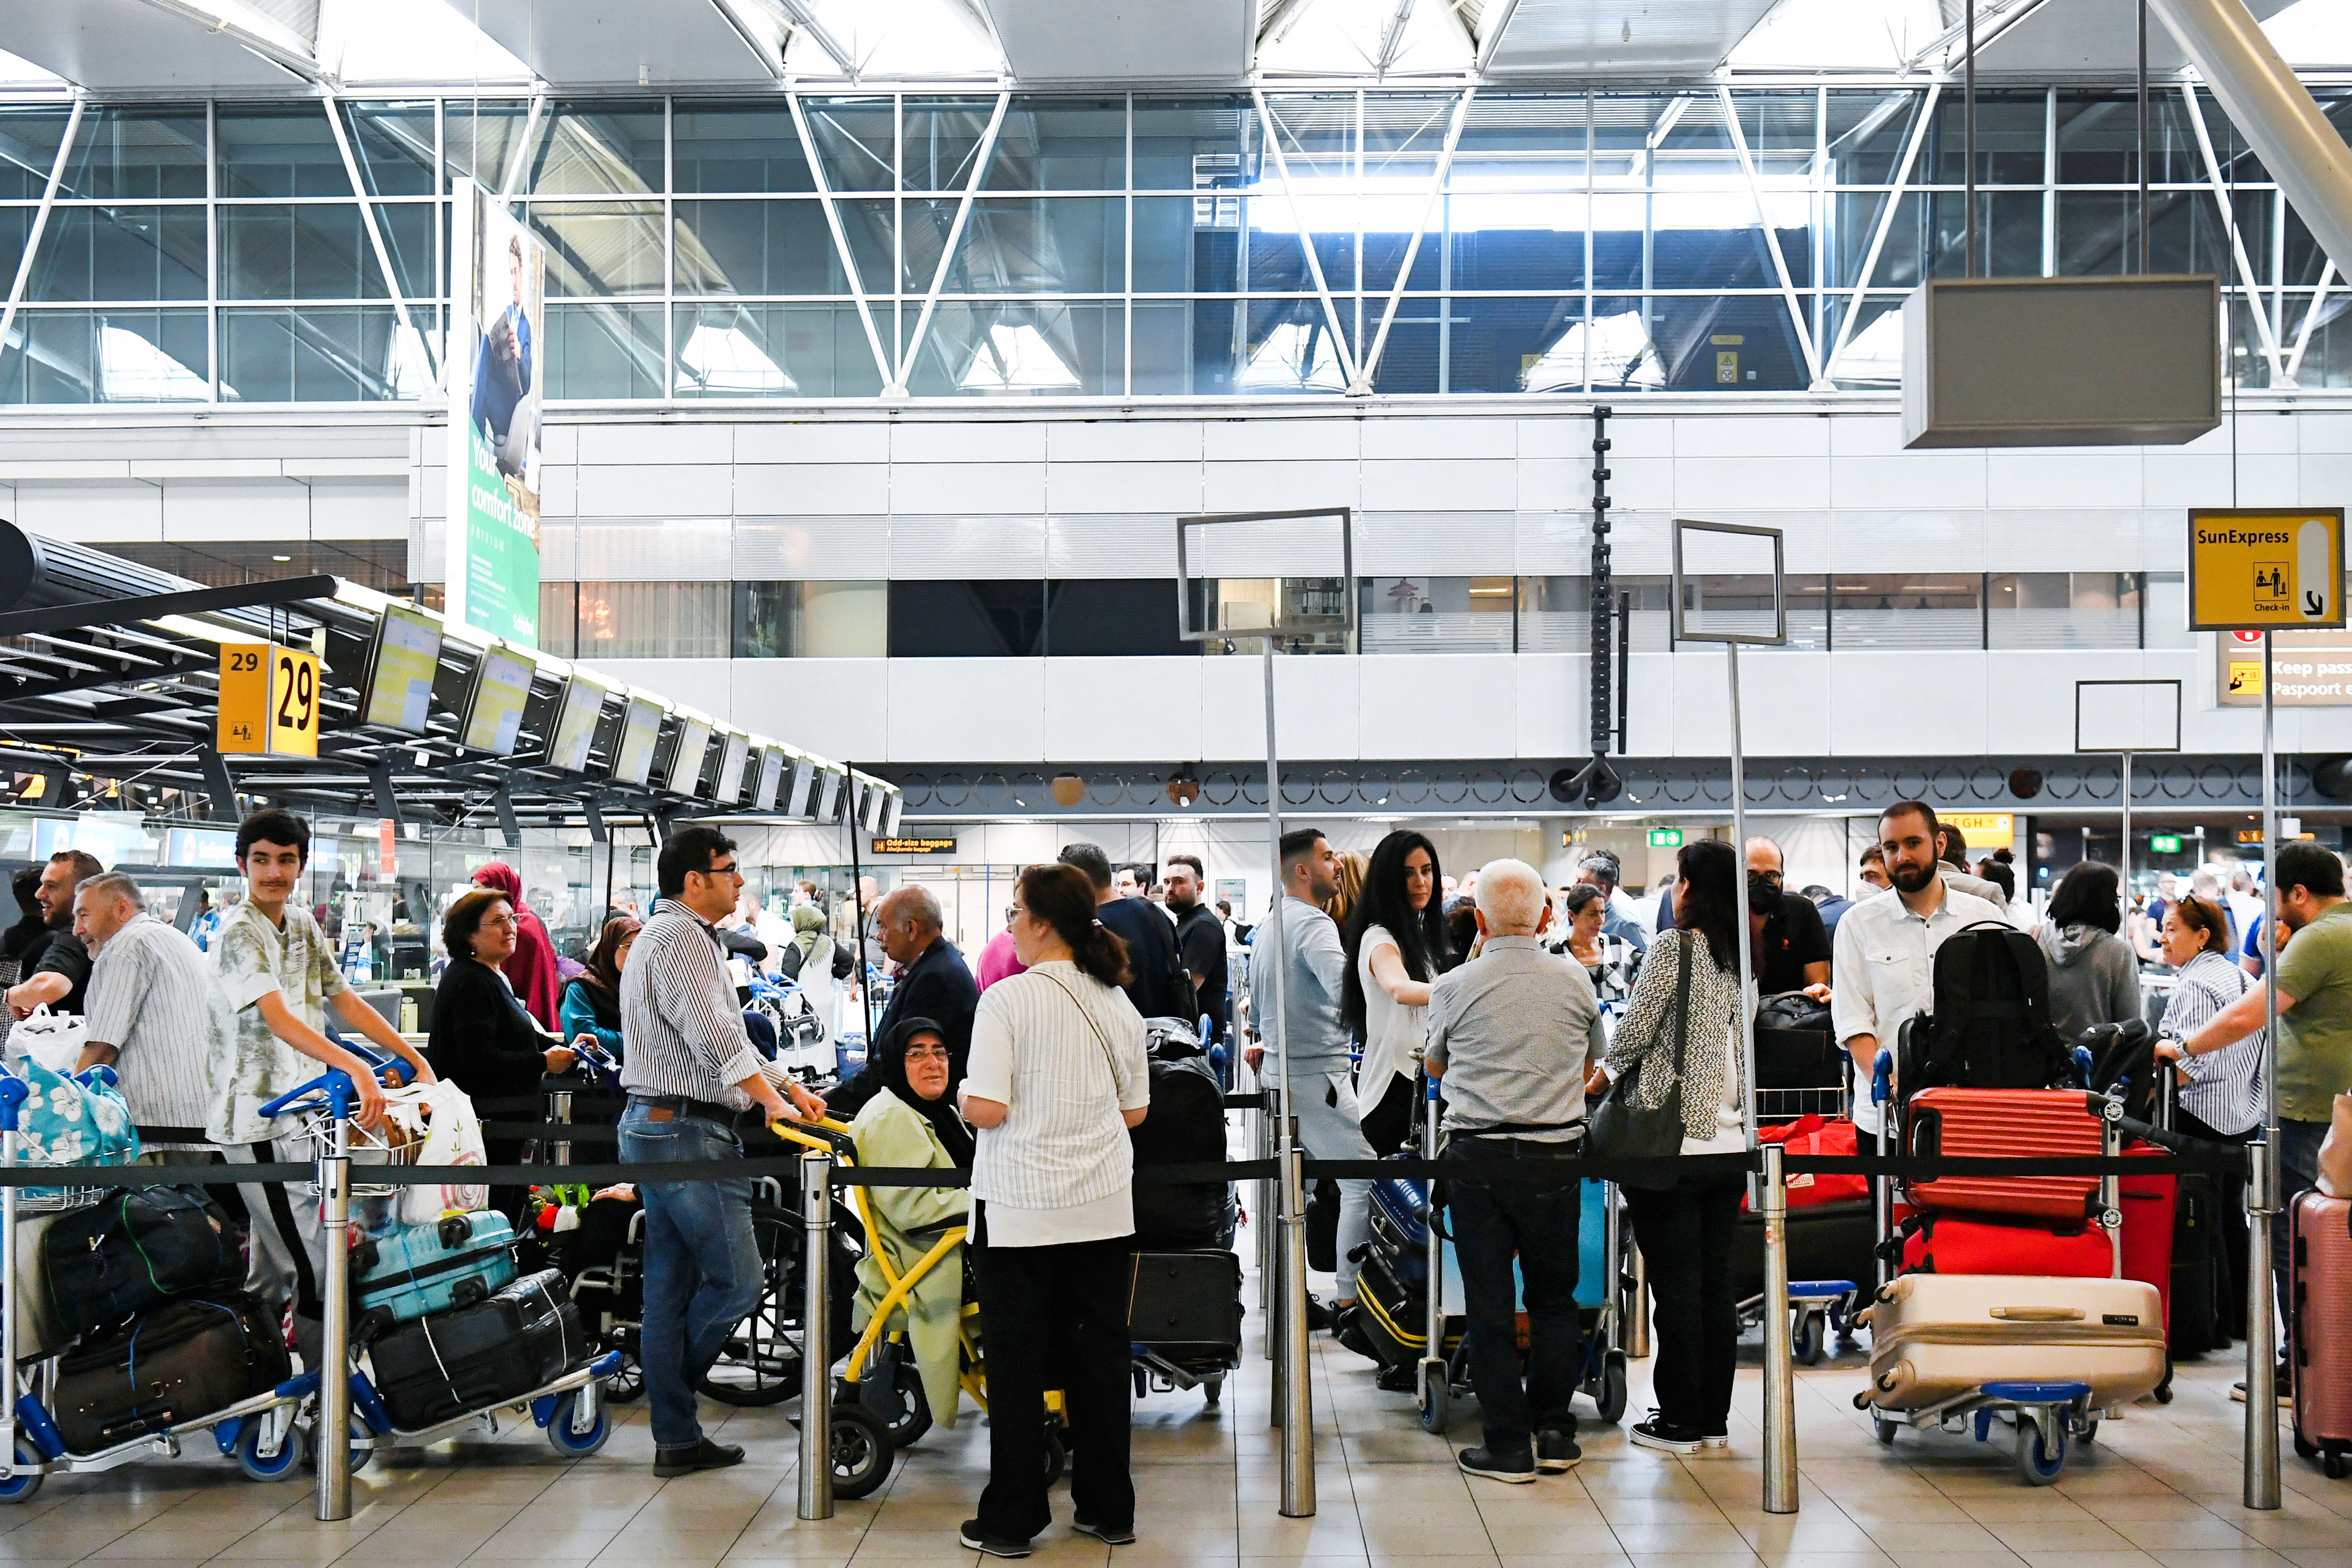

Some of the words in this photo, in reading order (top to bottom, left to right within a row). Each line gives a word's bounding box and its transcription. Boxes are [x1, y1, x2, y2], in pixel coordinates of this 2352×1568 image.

[473, 435, 498, 478] Your
[471, 484, 512, 527] comfort
[512, 507, 536, 540] zone
[471, 524, 505, 552] PRIVIUM
[2198, 529, 2289, 547] SunExpress
[2254, 603, 2290, 612] Check-in
[513, 613, 535, 637] Schiphol
[231, 653, 258, 672] 29
[2272, 661, 2313, 677] Keep
[277, 657, 313, 731] 29
[2272, 682, 2342, 699] Paspoort
[920, 839, 953, 848] baggage
